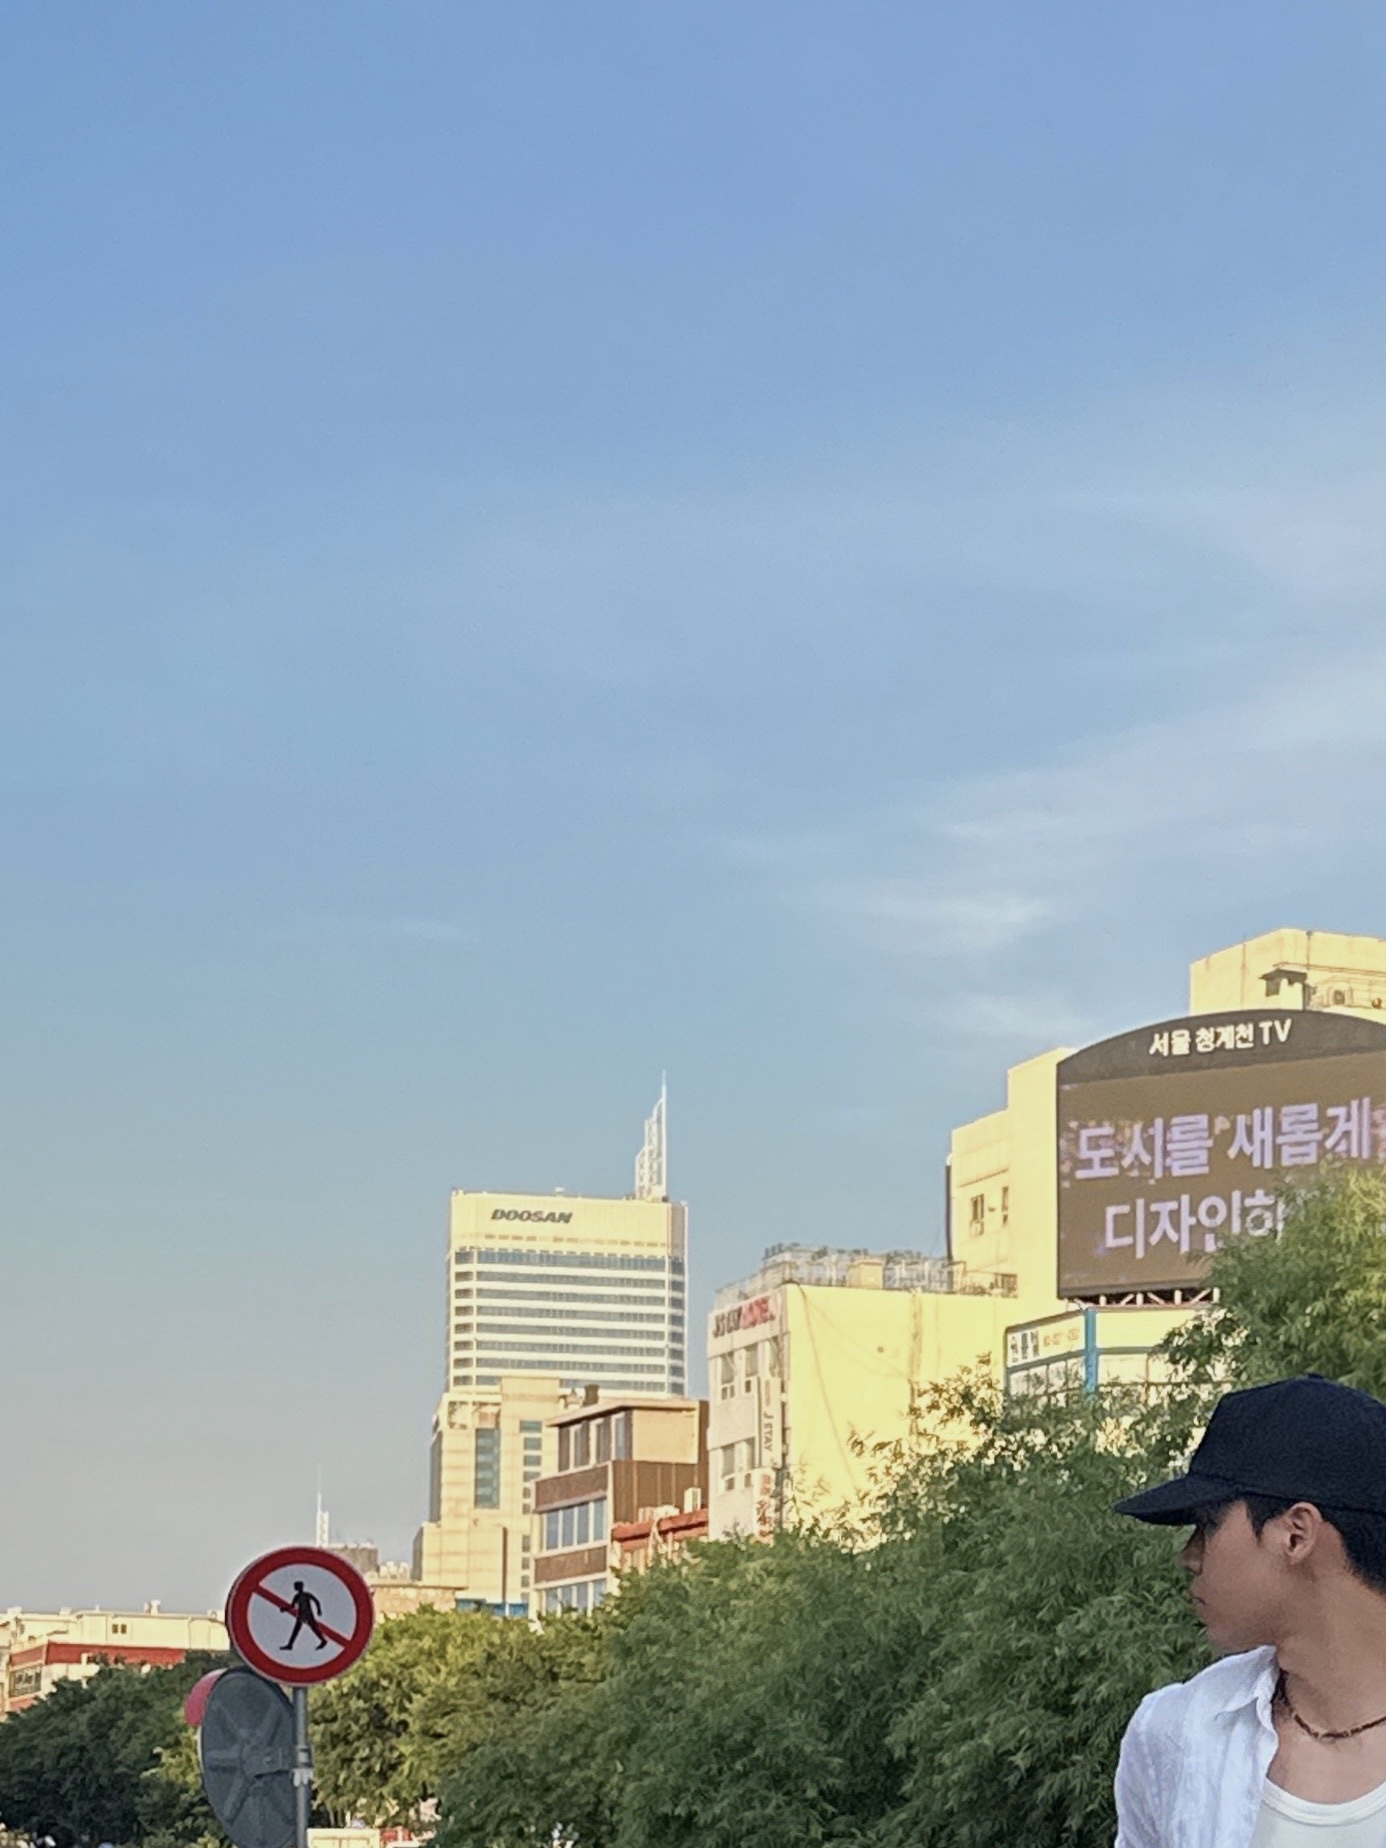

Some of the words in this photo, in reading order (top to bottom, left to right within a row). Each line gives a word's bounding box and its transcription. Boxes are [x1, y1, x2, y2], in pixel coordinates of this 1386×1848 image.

[1149, 1030, 1192, 1057] 서울
[1195, 1024, 1254, 1052] 청계천
[1259, 1018, 1292, 1046] TV
[1074, 1112, 1214, 1181] 도시를
[1226, 1097, 1372, 1170] 새롭게
[490, 1208, 573, 1224] DOOSAN
